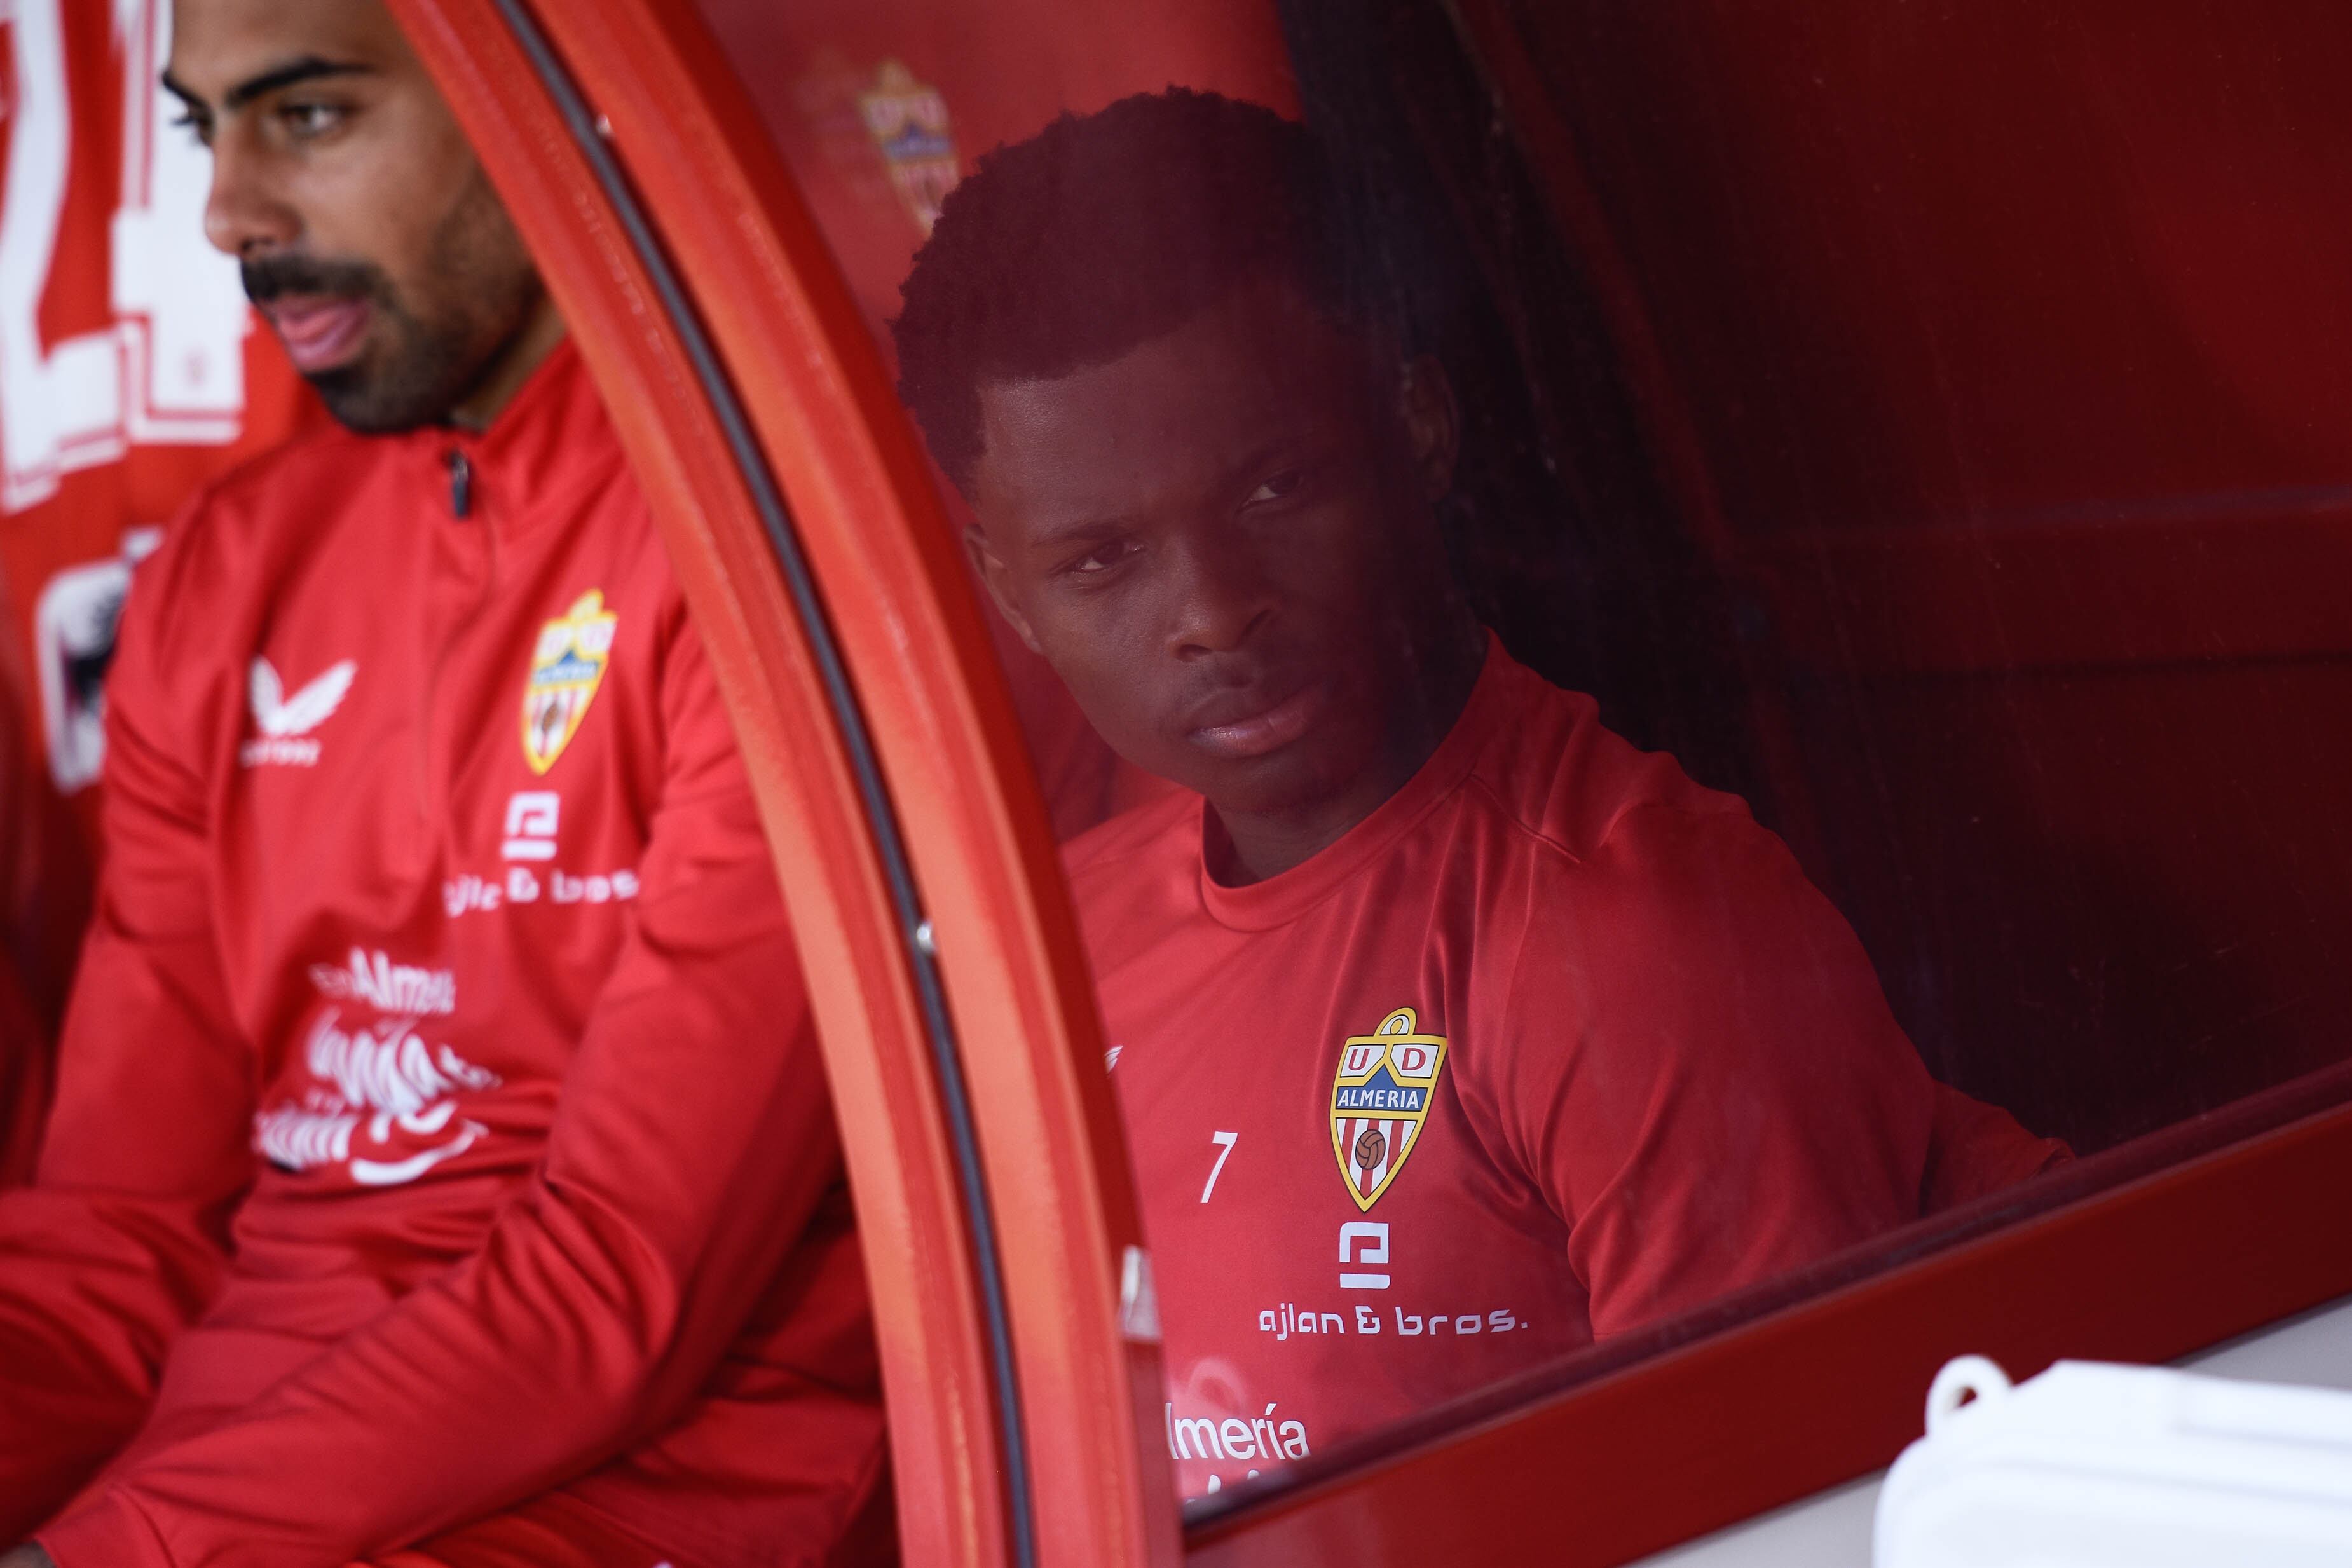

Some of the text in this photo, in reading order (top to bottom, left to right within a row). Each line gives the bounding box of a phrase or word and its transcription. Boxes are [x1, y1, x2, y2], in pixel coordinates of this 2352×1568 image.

[1348, 1047, 1426, 1071] U D
[1337, 1089, 1419, 1109] ALMERIA
[1200, 1131, 1238, 1203] 7
[1259, 1302, 1528, 1341] ajlan & bros.
[1165, 1402, 1311, 1461] lmería
